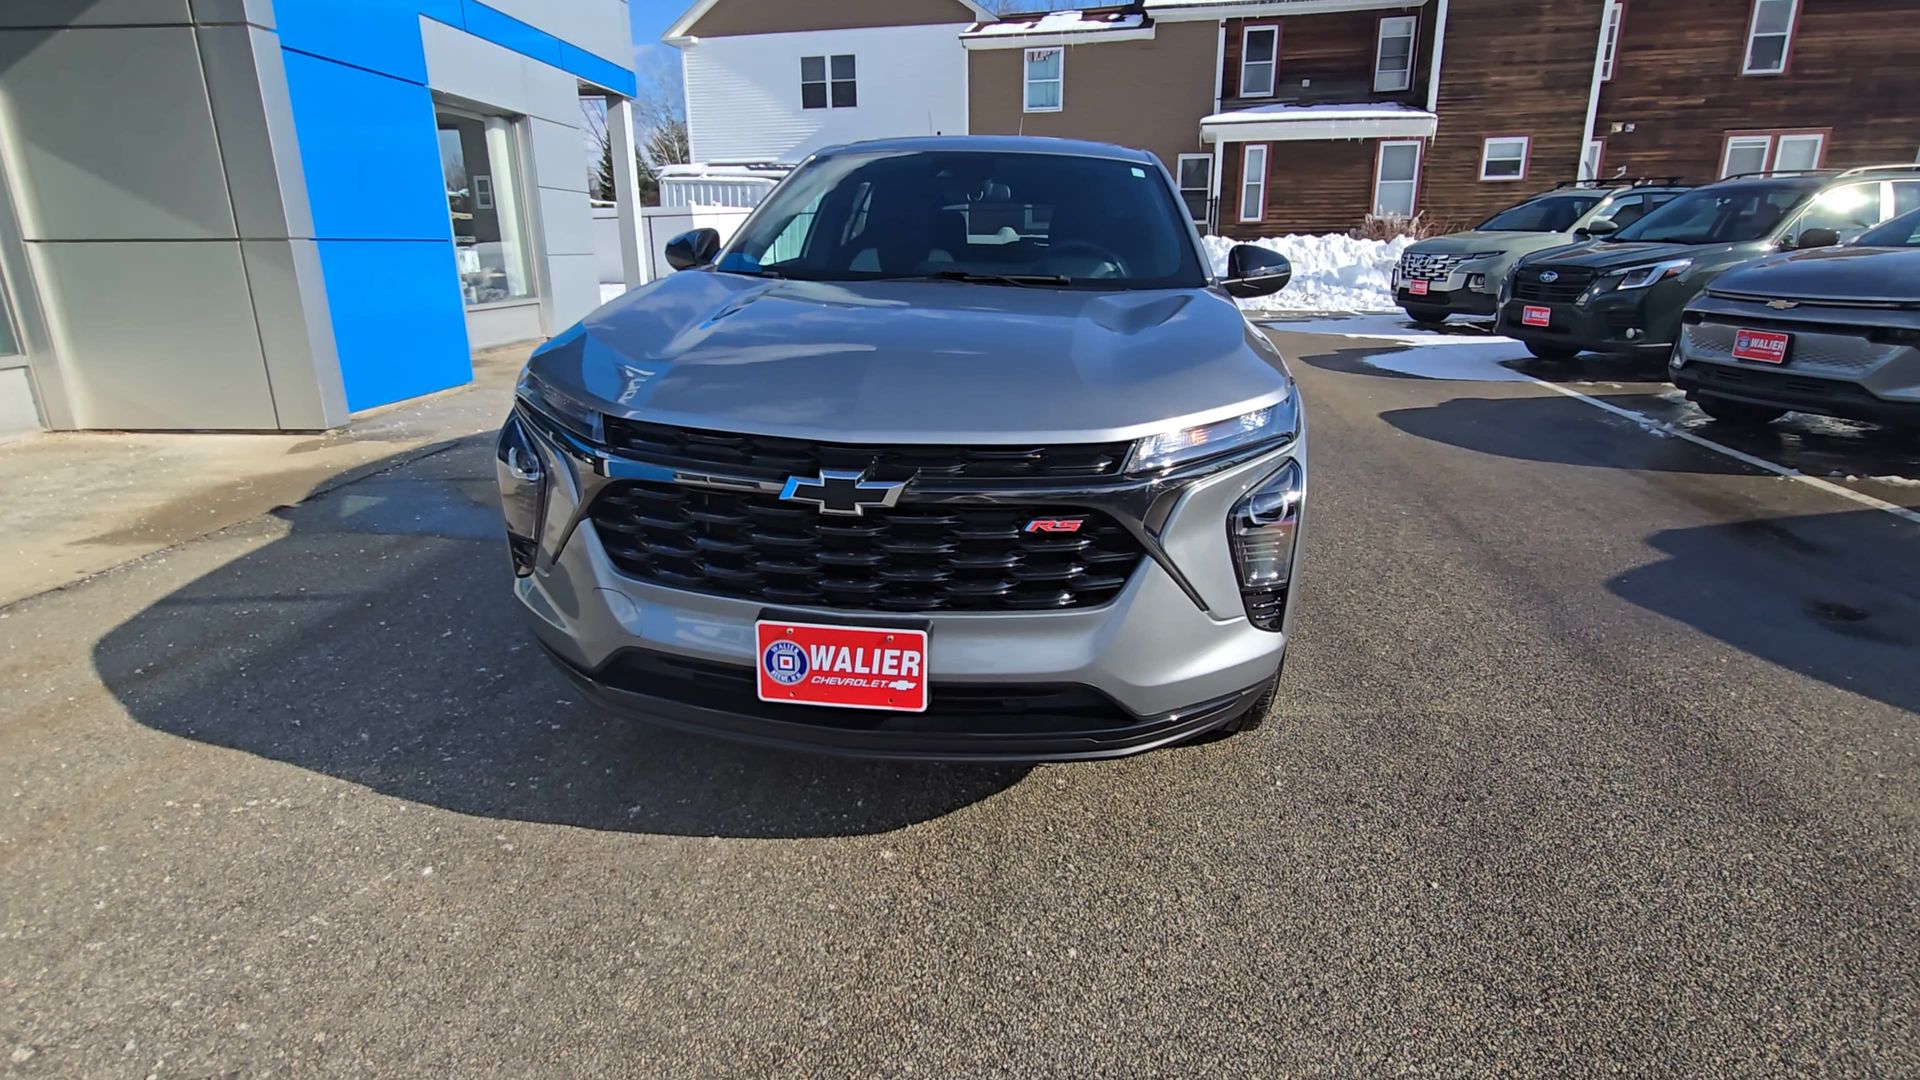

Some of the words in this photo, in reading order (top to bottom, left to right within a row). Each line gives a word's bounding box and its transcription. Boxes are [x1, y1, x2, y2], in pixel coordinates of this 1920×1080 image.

[1750, 337, 1785, 351] WALIER
[1025, 519, 1084, 532] RS
[810, 644, 921, 676] WALIER
[811, 675, 888, 688] CHEVROLET
